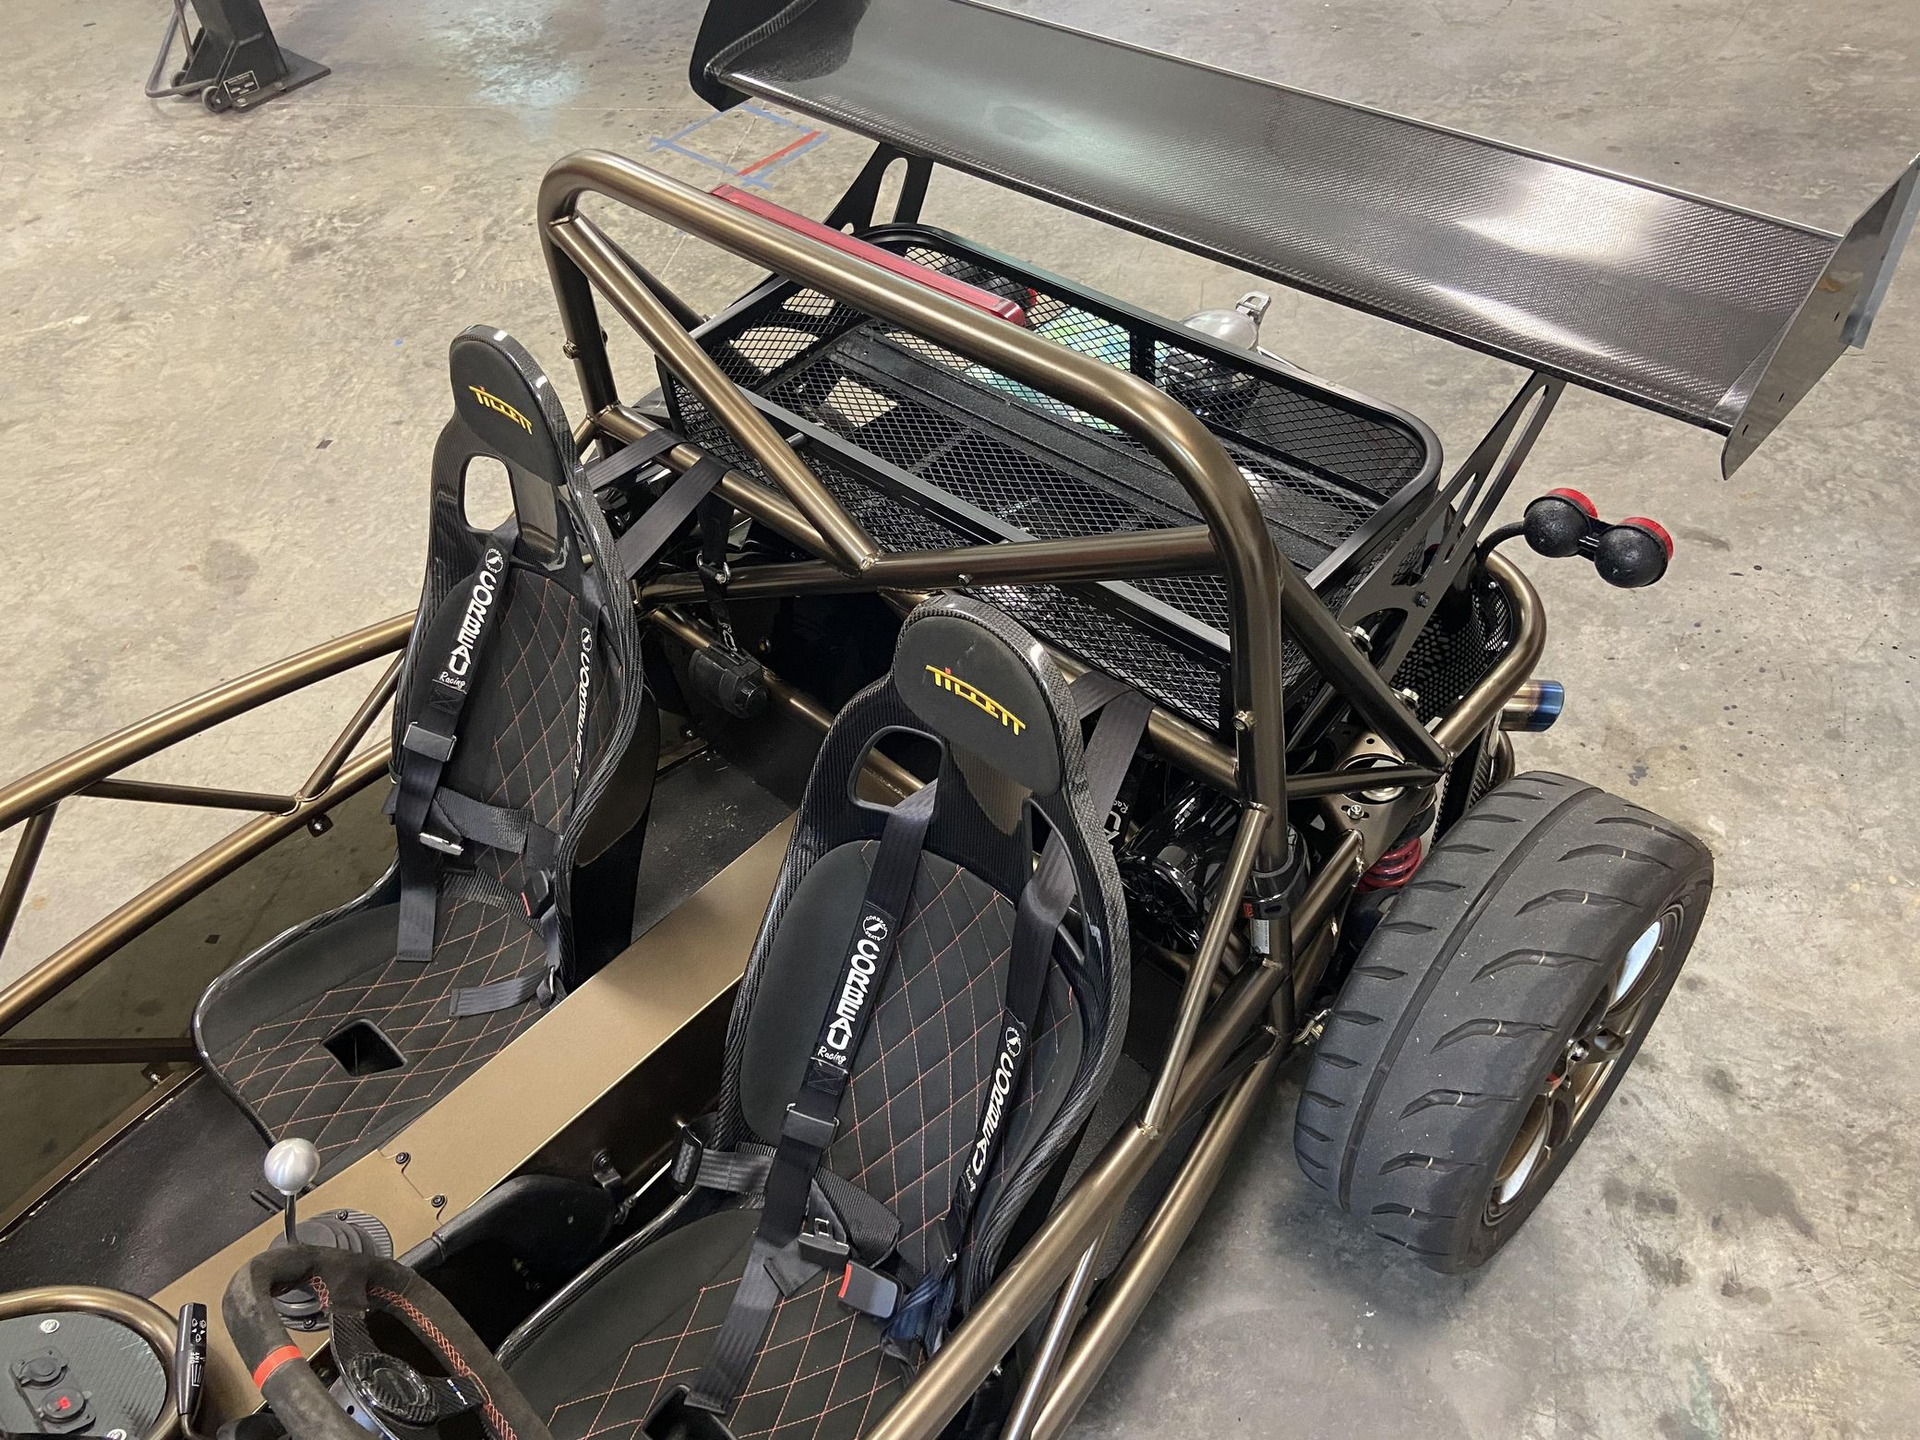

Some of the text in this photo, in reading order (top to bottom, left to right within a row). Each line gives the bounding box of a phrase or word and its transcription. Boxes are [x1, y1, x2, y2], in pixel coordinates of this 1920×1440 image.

[448, 570, 497, 676] CORBEAU
[439, 671, 466, 690] Racing
[826, 938, 880, 1051] CORBEAU
[817, 1045, 847, 1065] Racing
[972, 1051, 1014, 1176] CORBEAU
